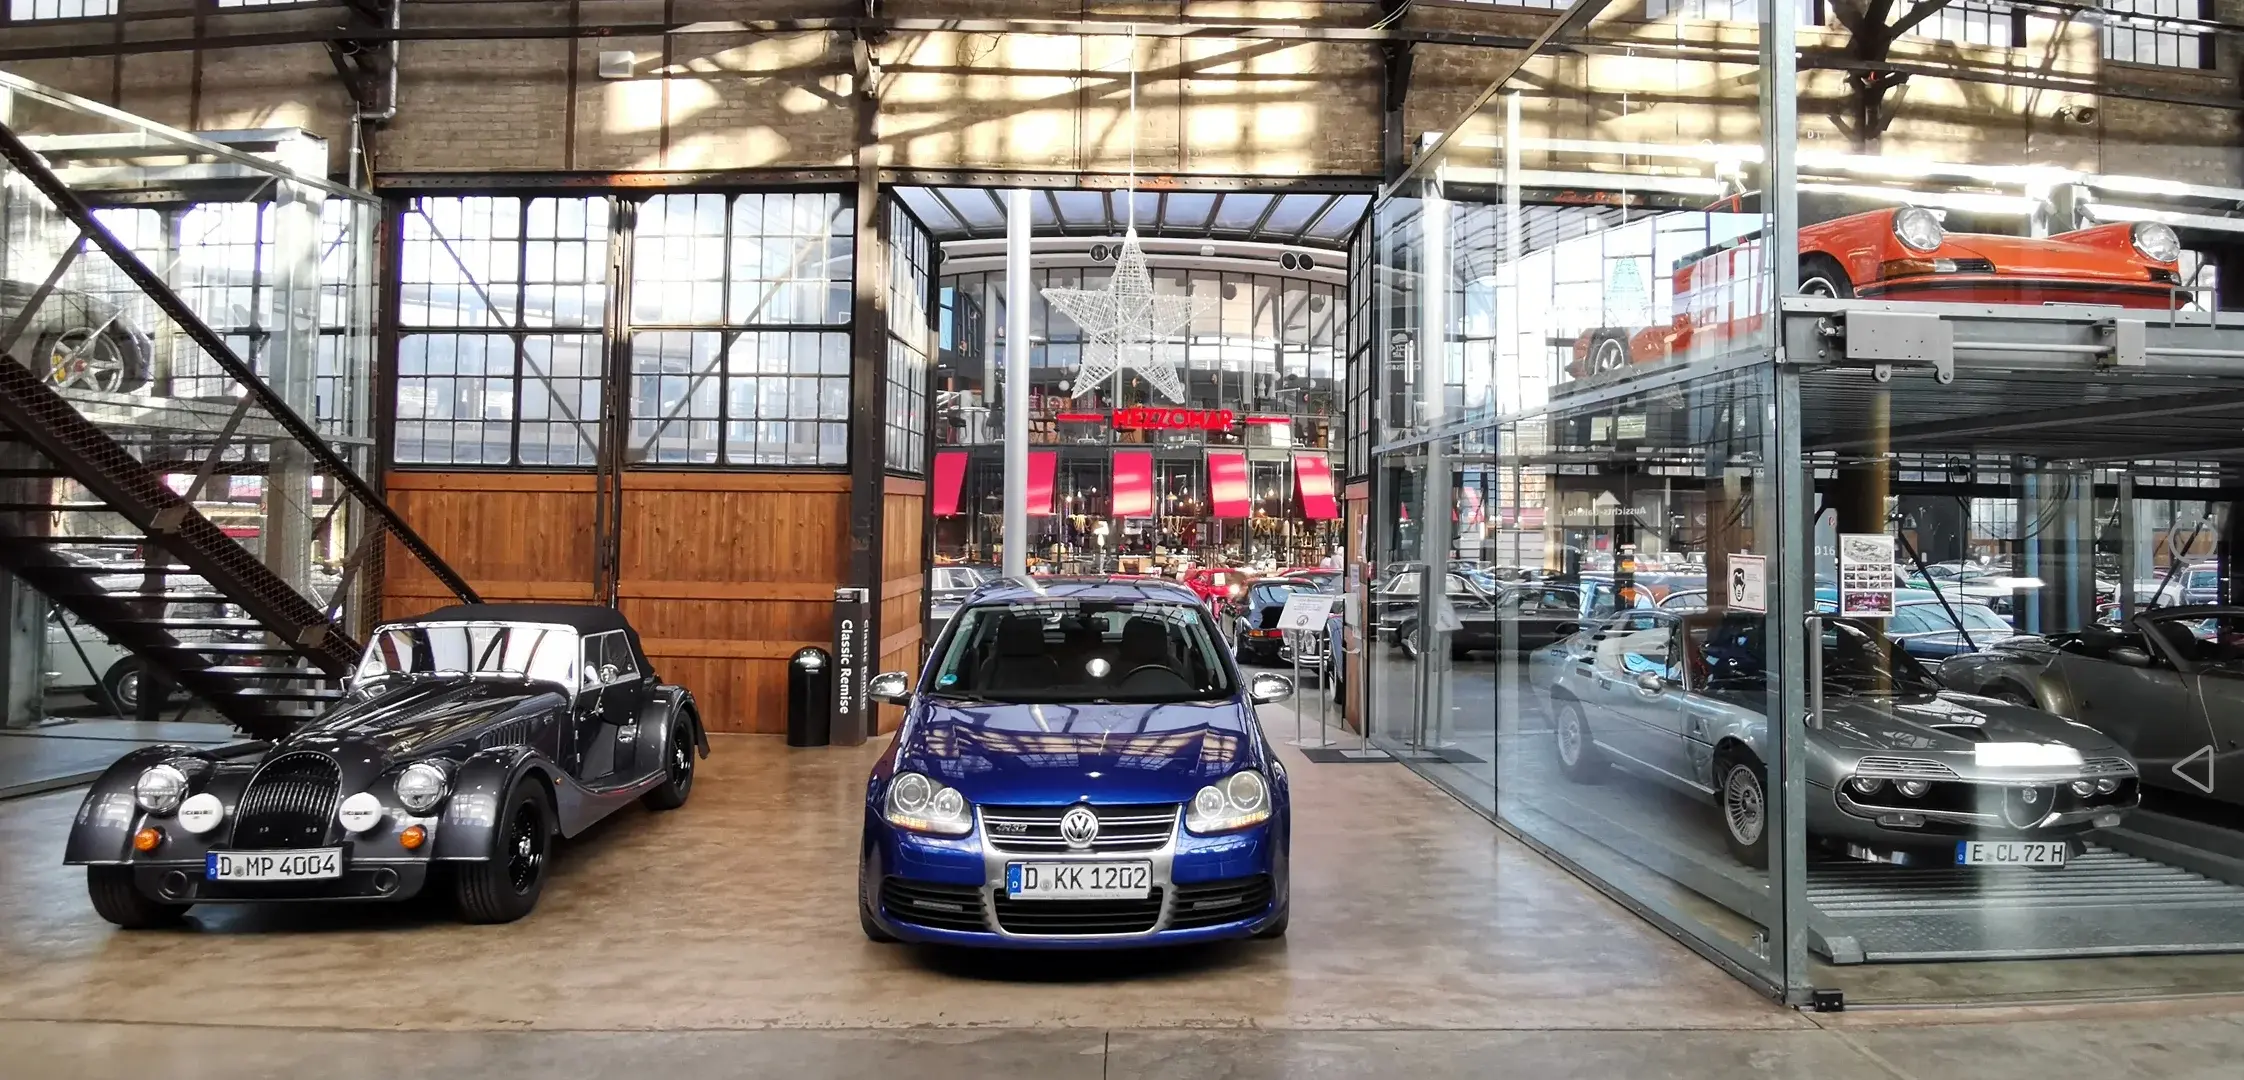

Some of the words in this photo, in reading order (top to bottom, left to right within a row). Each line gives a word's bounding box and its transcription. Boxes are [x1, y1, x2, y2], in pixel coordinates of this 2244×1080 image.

[1112, 408, 1234, 430] MEZZOMAR
[1823, 546, 1836, 556] 16
[841, 619, 853, 665] Classic
[840, 668, 852, 714] Remise
[1972, 844, 1984, 862] E
[1996, 844, 2019, 862] CL
[2023, 844, 2045, 862] 72
[2051, 844, 2063, 862] H
[220, 856, 232, 876] D
[246, 856, 273, 876] MP
[280, 854, 336, 876] 4004
[1024, 867, 1038, 889] D
[1055, 867, 1084, 889] KK
[1090, 867, 1147, 889] 1202
